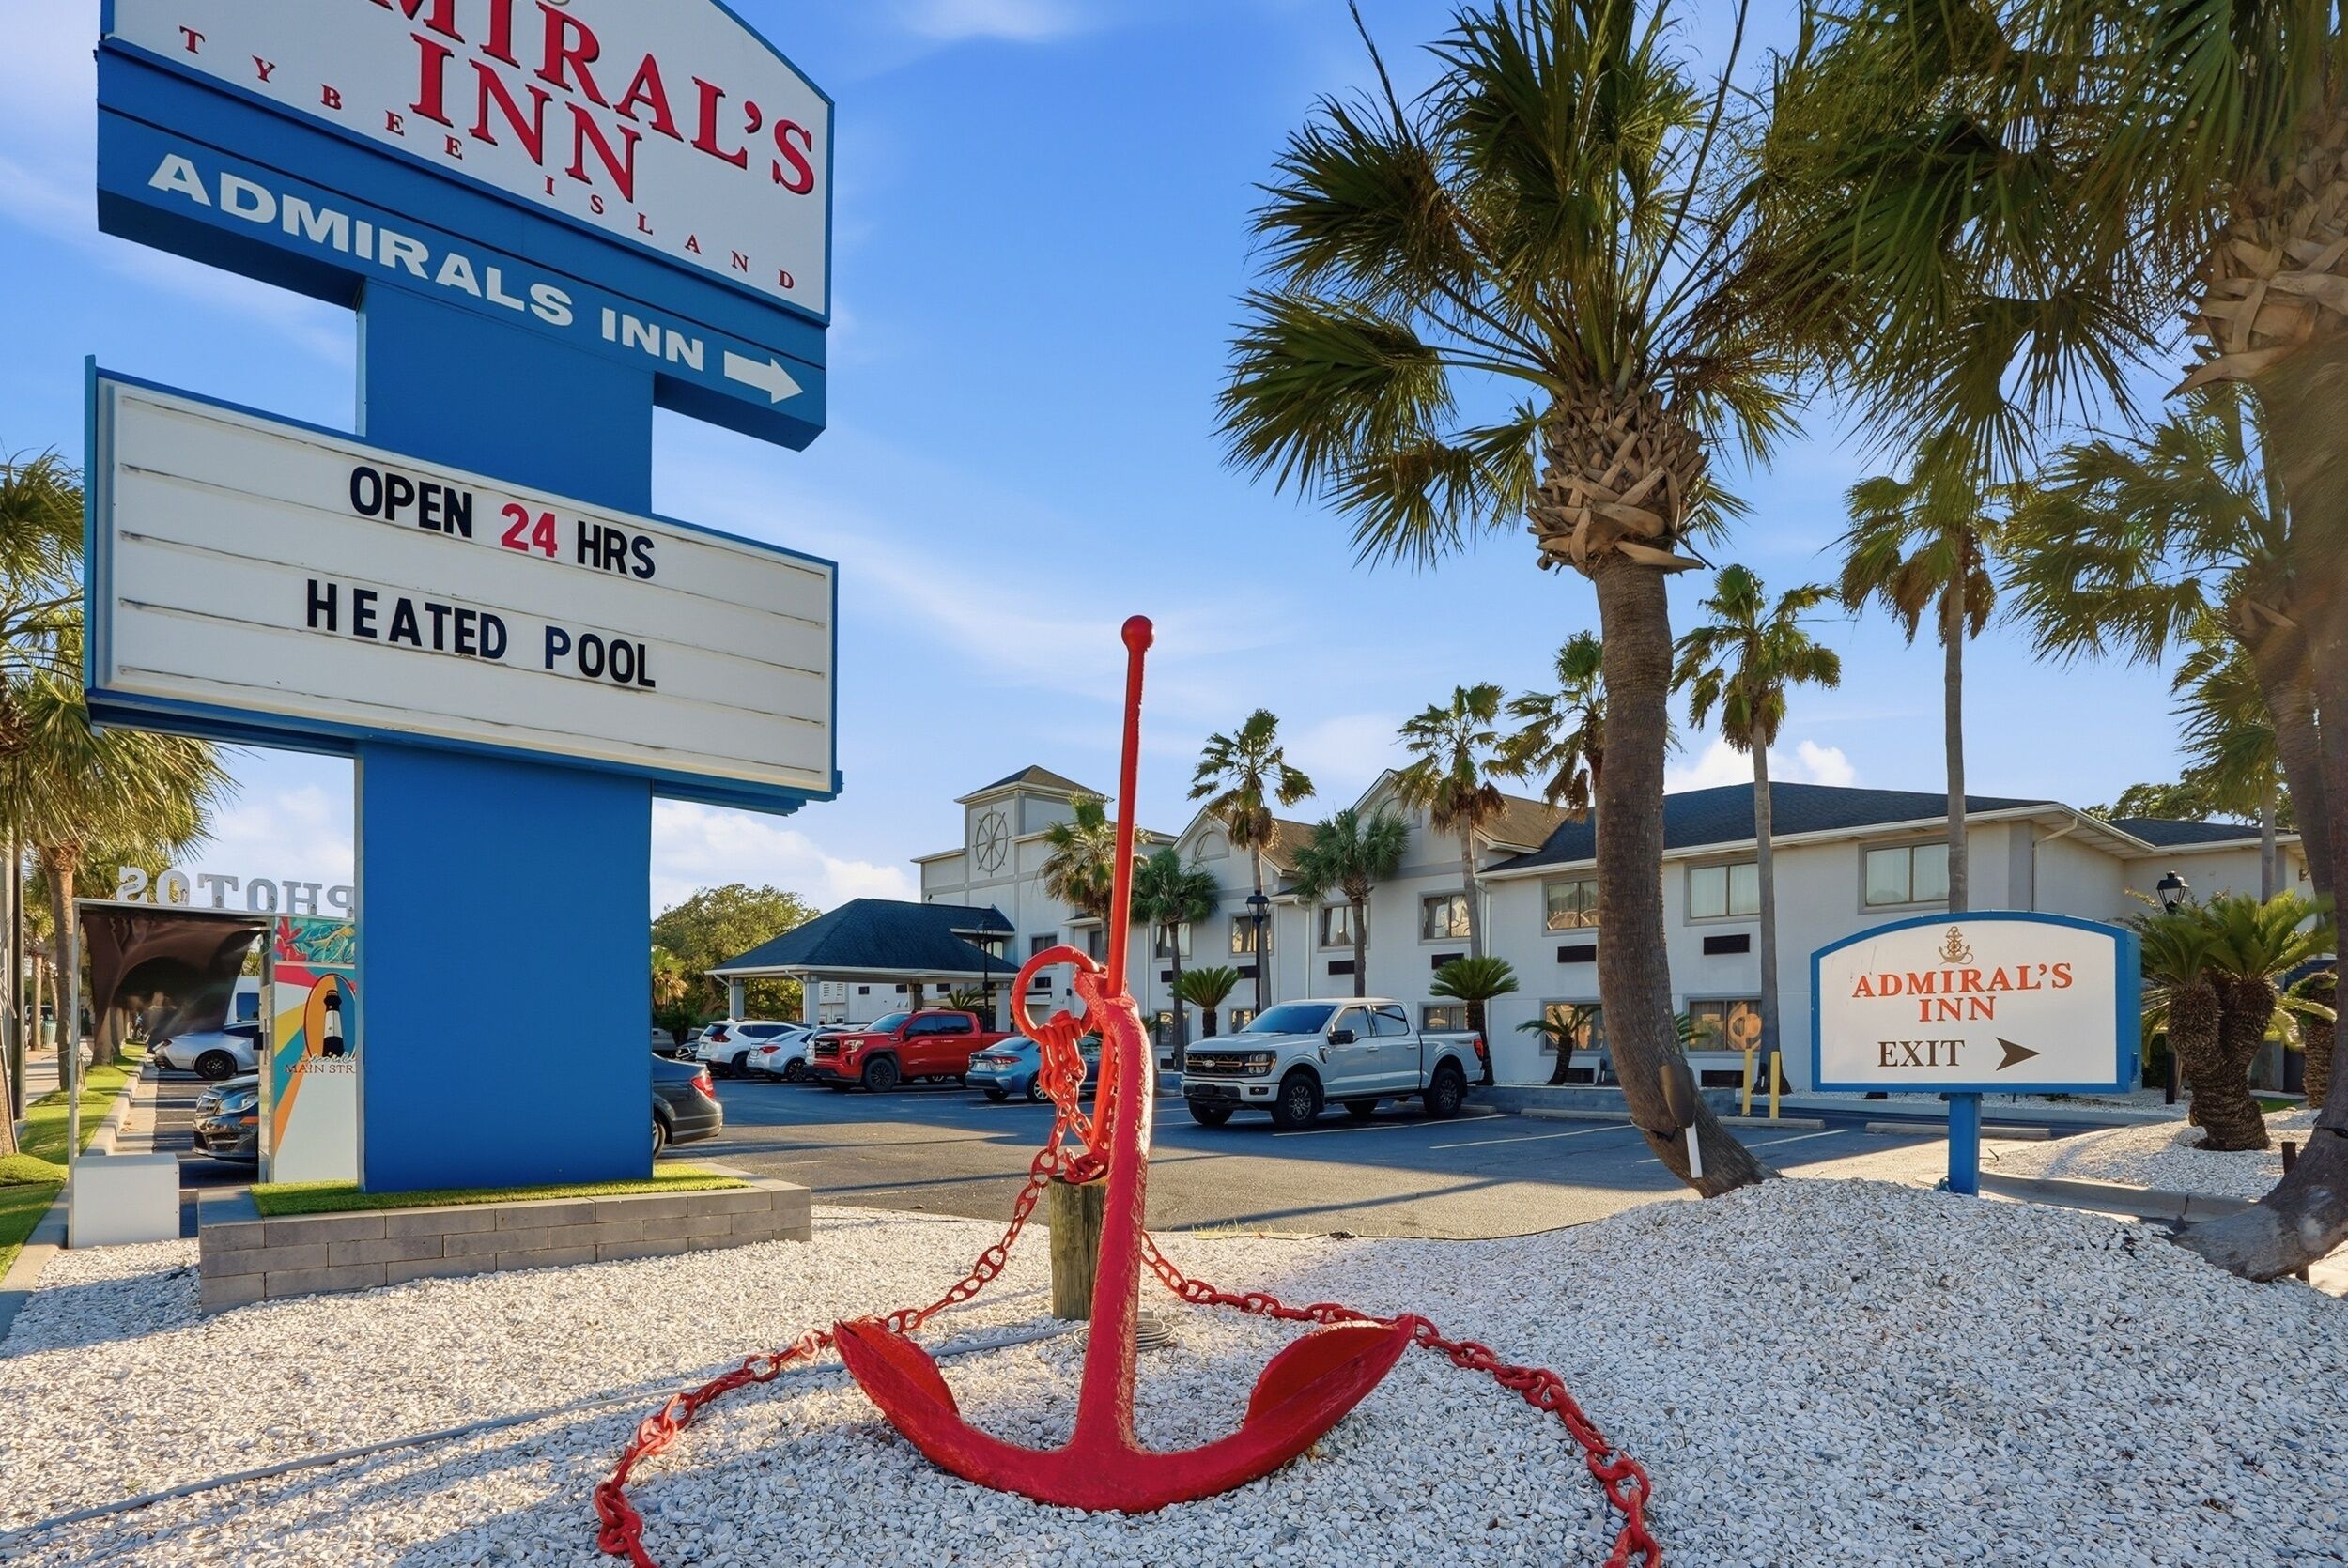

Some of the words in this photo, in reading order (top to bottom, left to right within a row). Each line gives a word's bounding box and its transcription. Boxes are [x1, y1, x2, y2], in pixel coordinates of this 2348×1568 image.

[178, 24, 464, 160] TYBEE
[545, 175, 796, 290] ISLAND
[409, 32, 642, 203] INN
[147, 153, 573, 326] ADMIRALS
[602, 307, 703, 372] INN
[349, 466, 473, 538] OPEN
[500, 503, 558, 558] 24
[577, 520, 657, 579] HRS
[307, 578, 507, 659] HEATED
[545, 625, 657, 688] POOL
[1852, 962, 2074, 998] ADMIRAL'S
[1919, 996, 1996, 1022] INN
[285, 1063, 324, 1074] MAIN
[1878, 1039, 1965, 1068] EXIT
